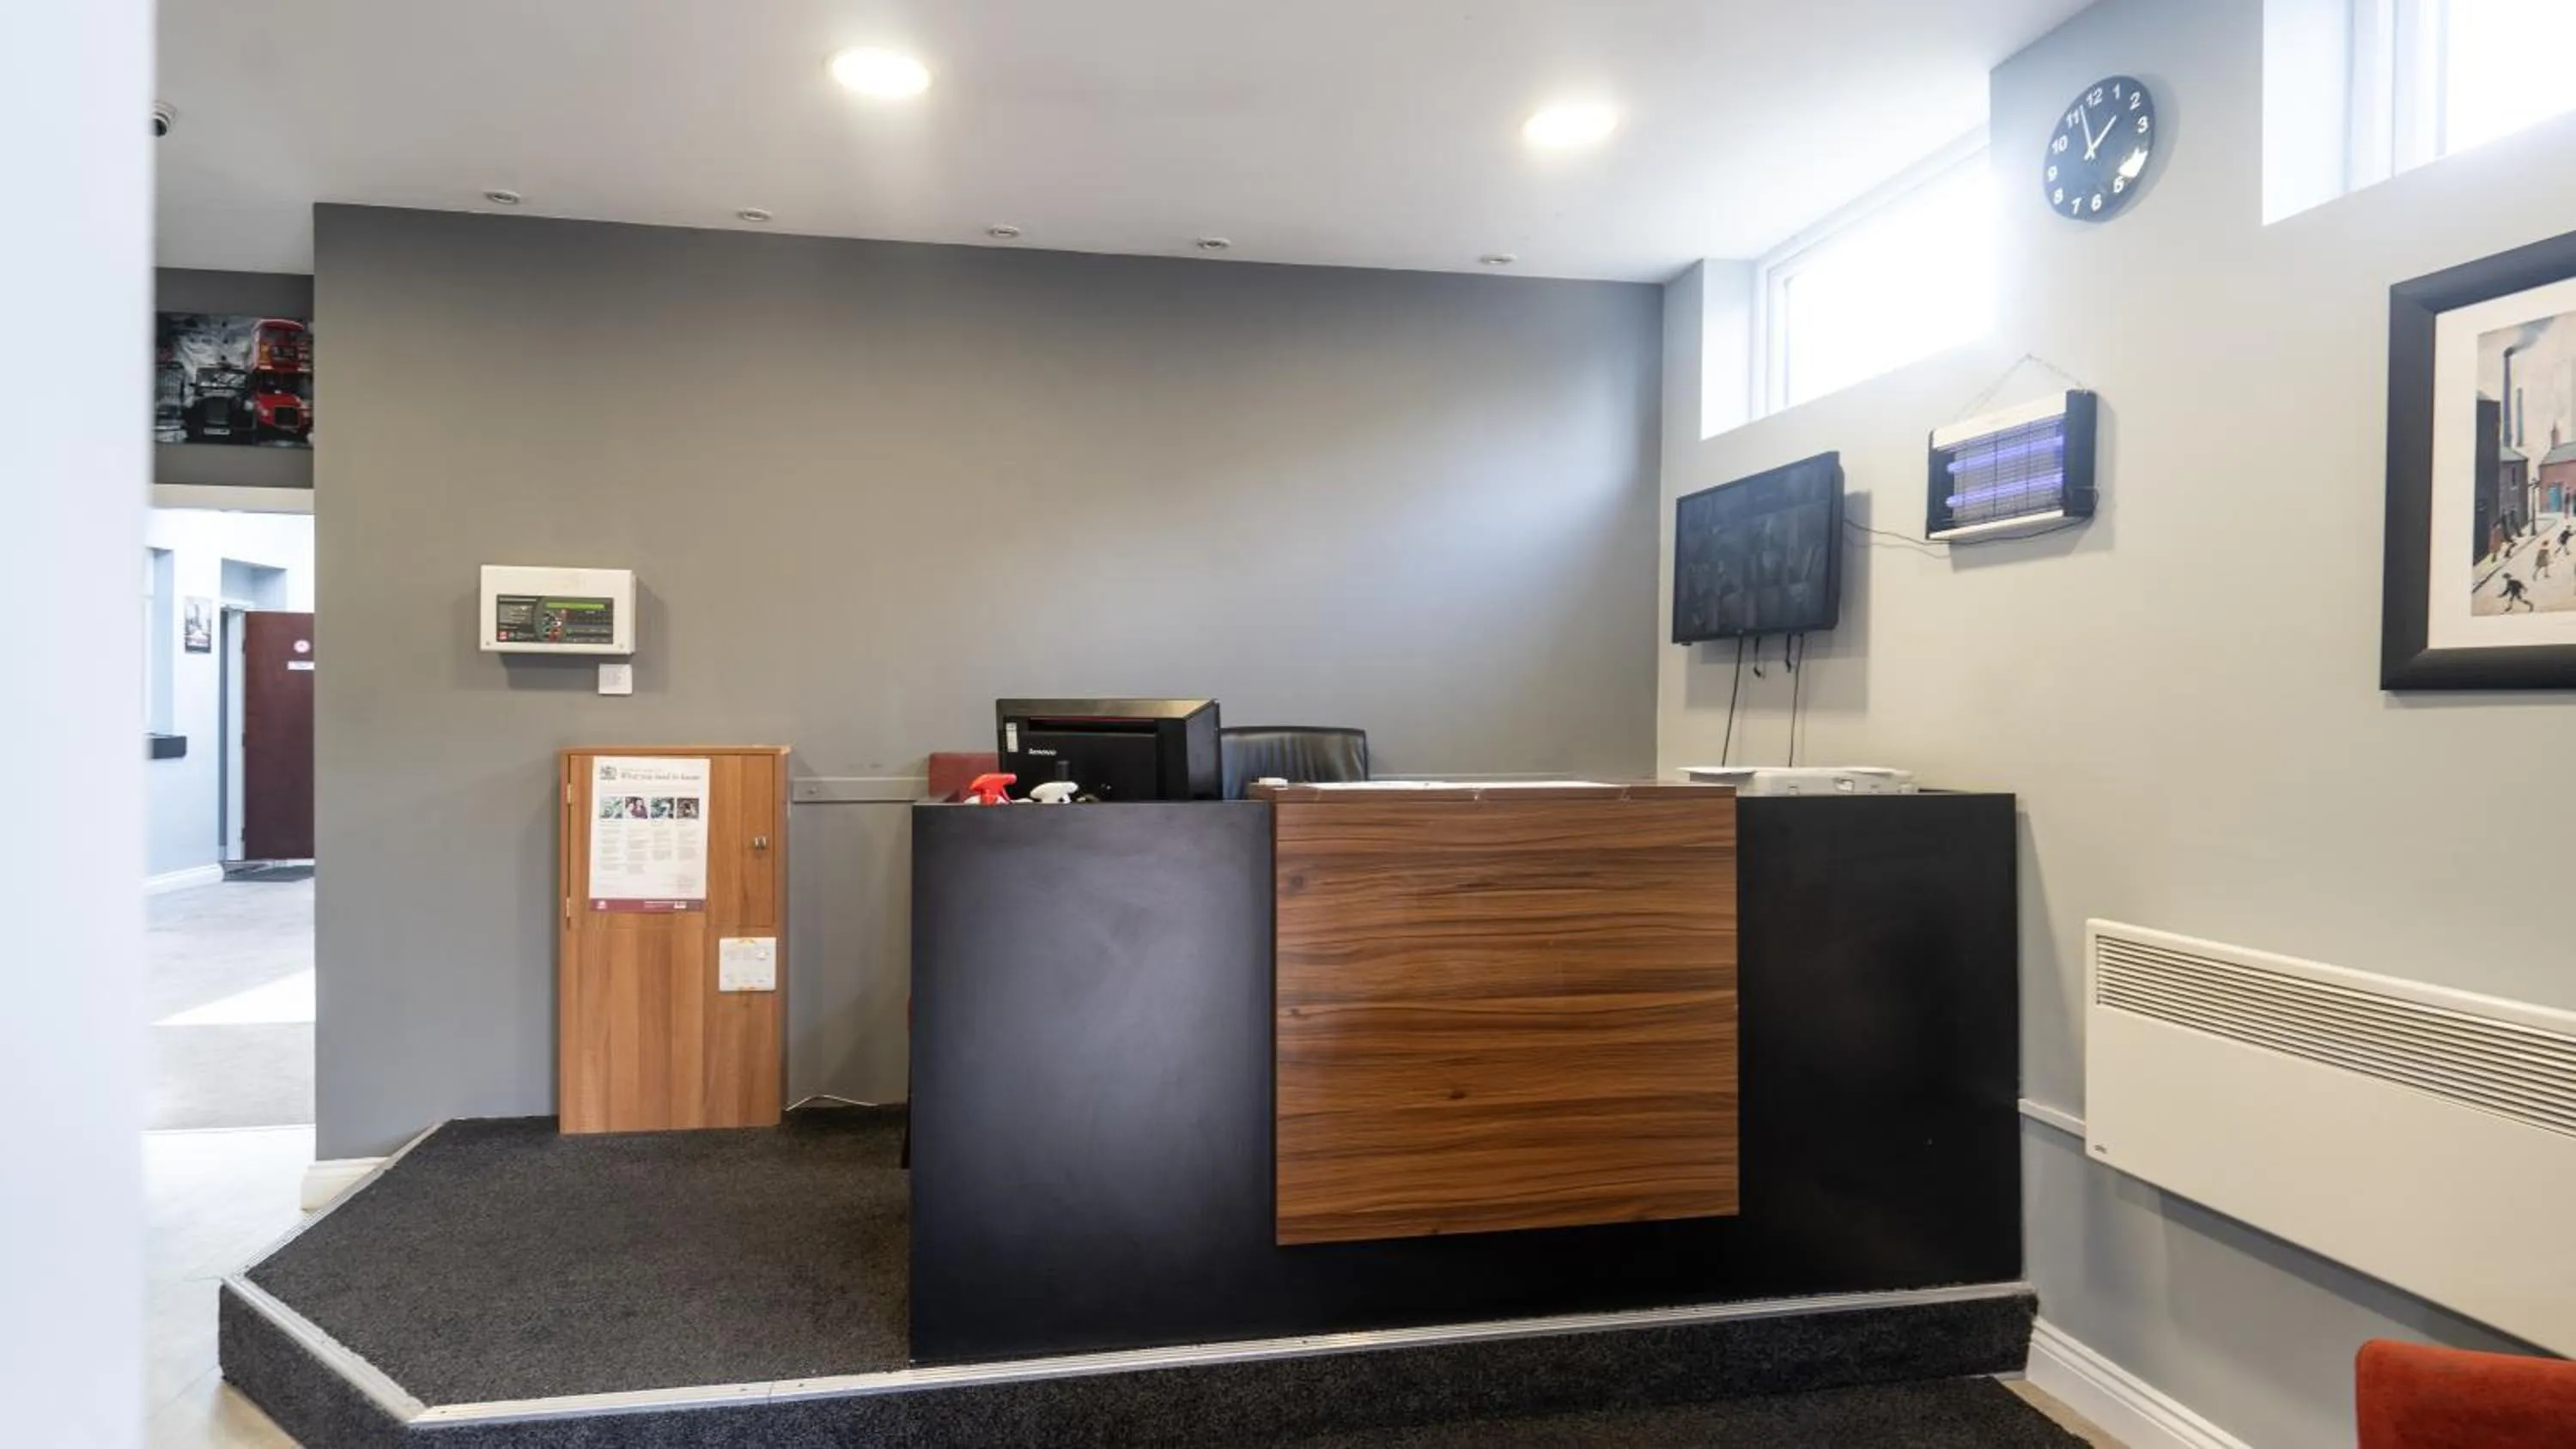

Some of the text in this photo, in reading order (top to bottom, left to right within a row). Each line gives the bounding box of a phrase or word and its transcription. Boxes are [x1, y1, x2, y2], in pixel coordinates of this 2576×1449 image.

[2087, 88, 2103, 107] 12
[2113, 83, 2121, 100] 1
[2129, 91, 2141, 110] 2
[2066, 109, 2079, 128] 11
[2137, 115, 2148, 134] 3
[2051, 135, 2068, 155] 10
[2047, 165, 2057, 182] 9
[2054, 187, 2063, 205] 8
[2091, 193, 2102, 212] 6
[2071, 197, 2082, 215] 7
